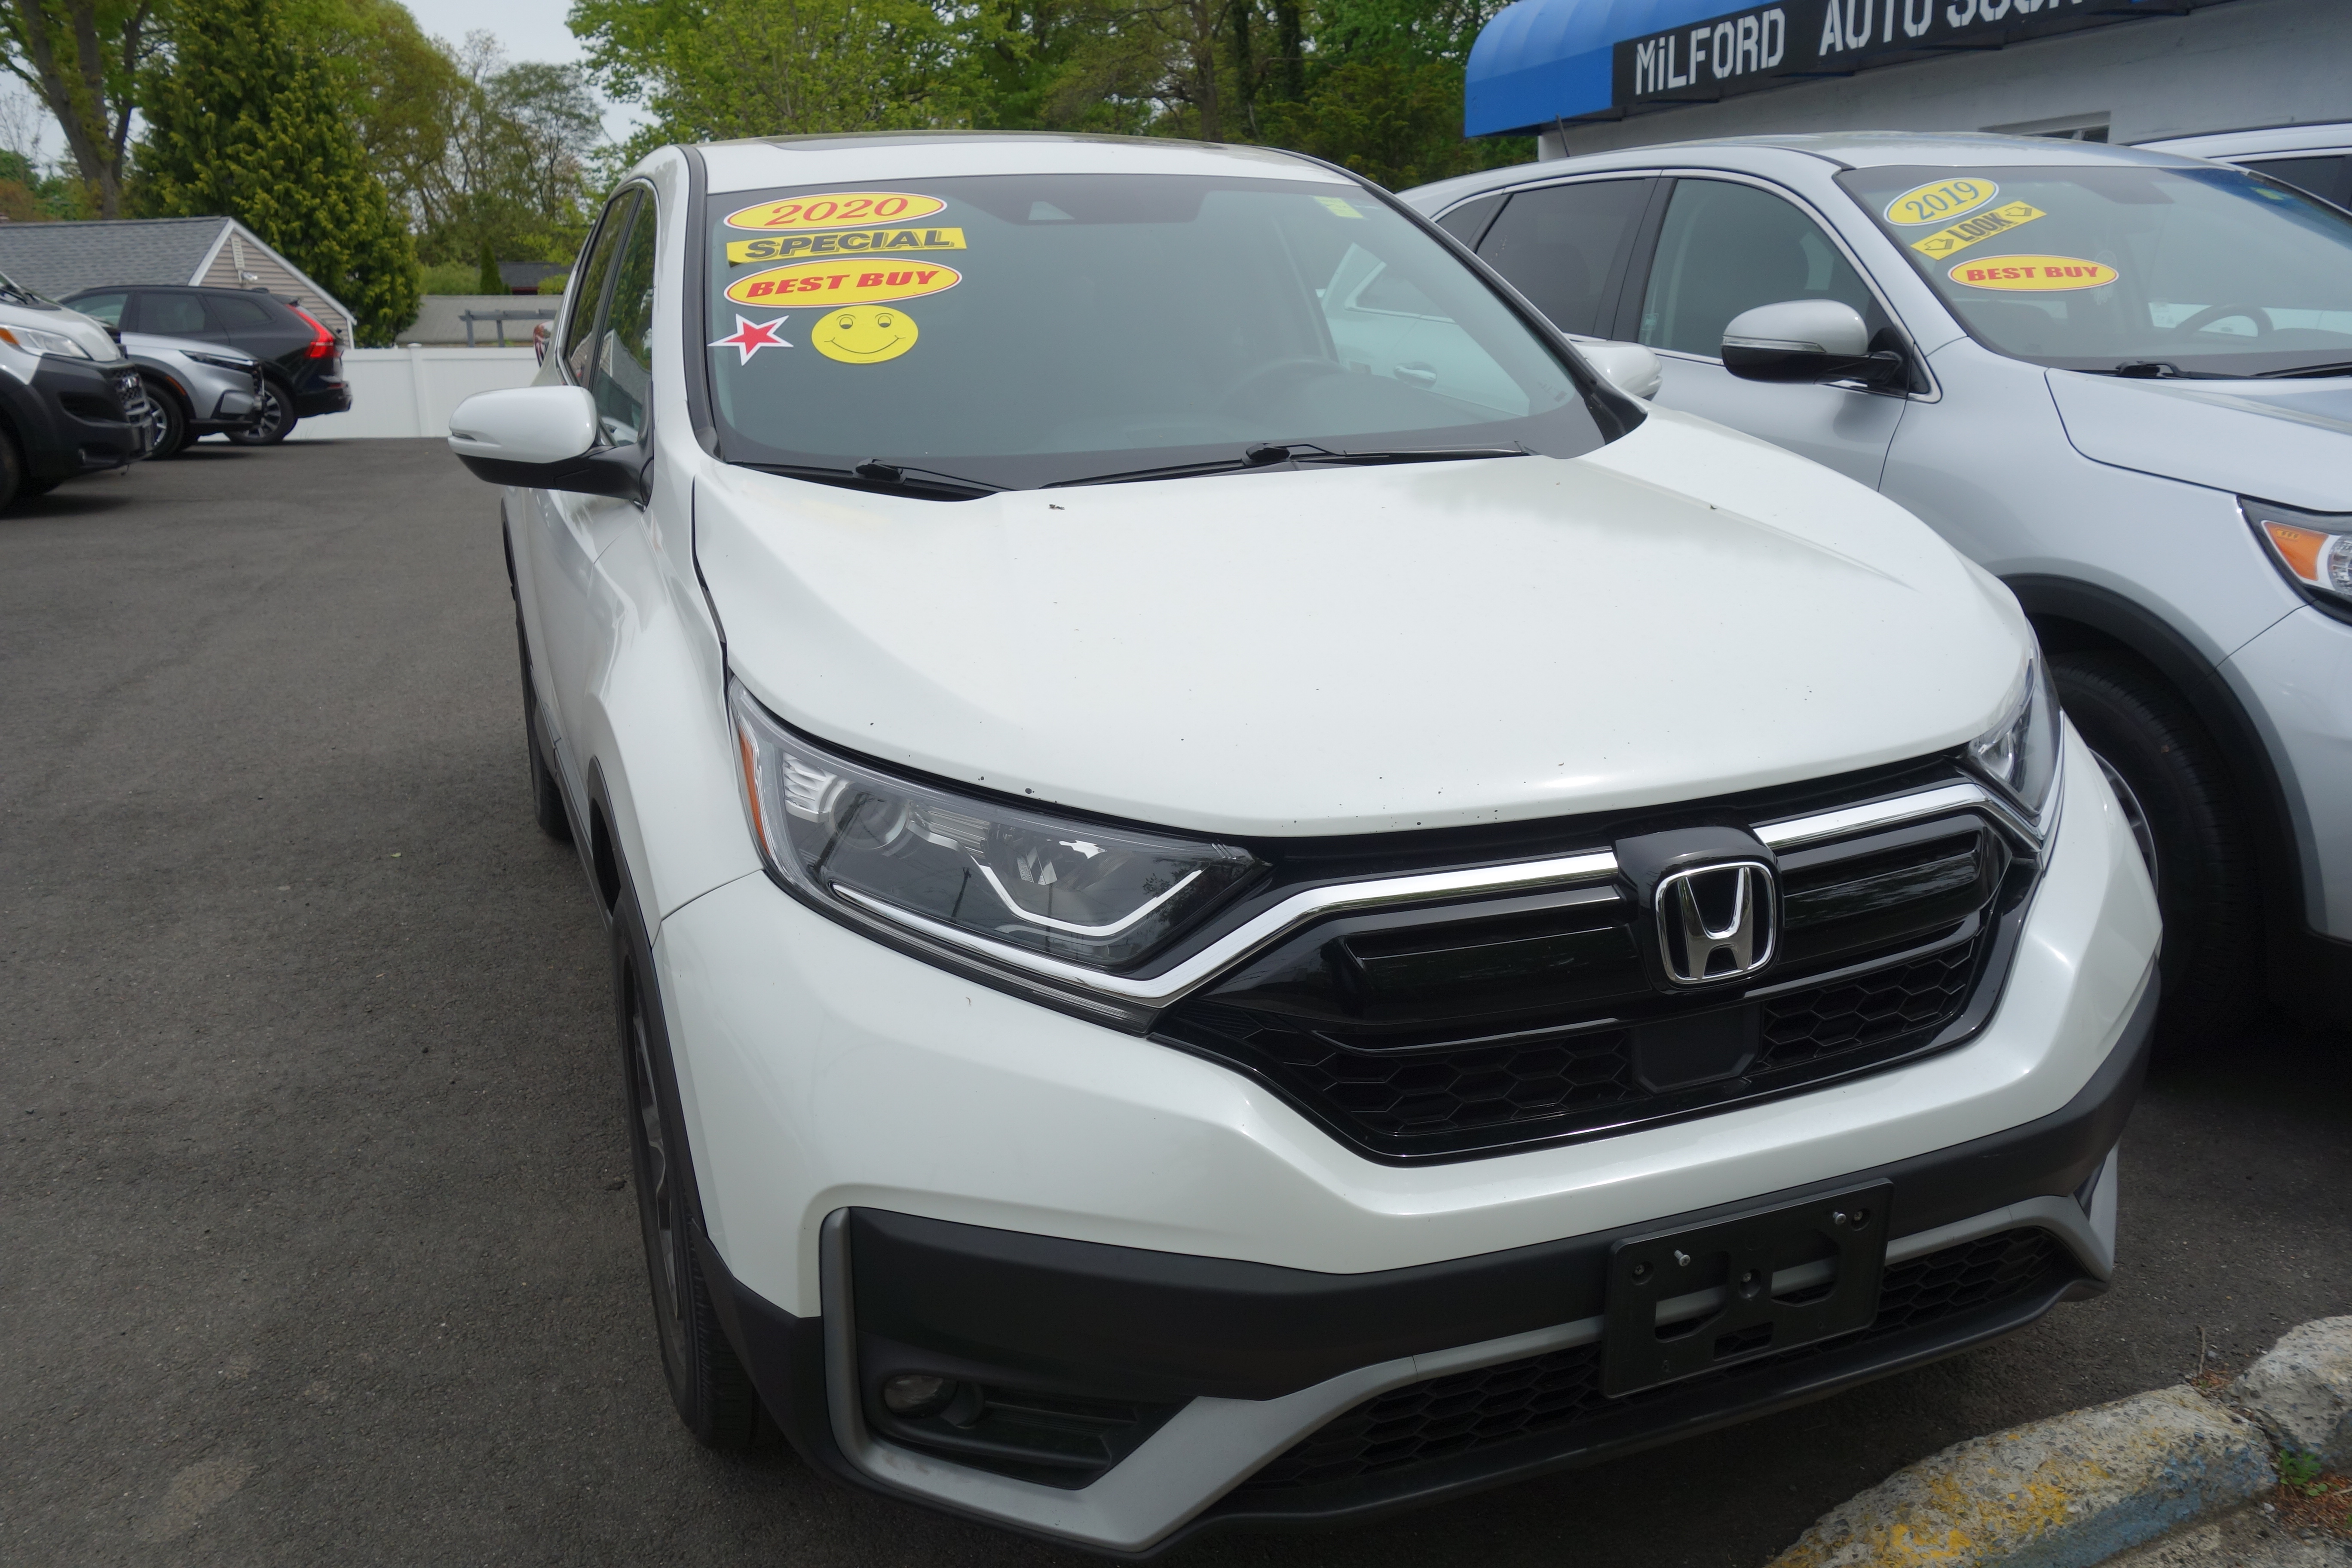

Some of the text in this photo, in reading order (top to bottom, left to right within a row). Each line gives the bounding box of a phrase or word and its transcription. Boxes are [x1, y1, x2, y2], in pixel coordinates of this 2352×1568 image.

[764, 197, 908, 226] 2020
[1905, 181, 1979, 220] 2019
[1945, 212, 2017, 242] LOOK
[744, 230, 954, 259] SPECIAL
[746, 270, 940, 298] BEST BUY
[1966, 266, 2098, 282] BEST BUY
